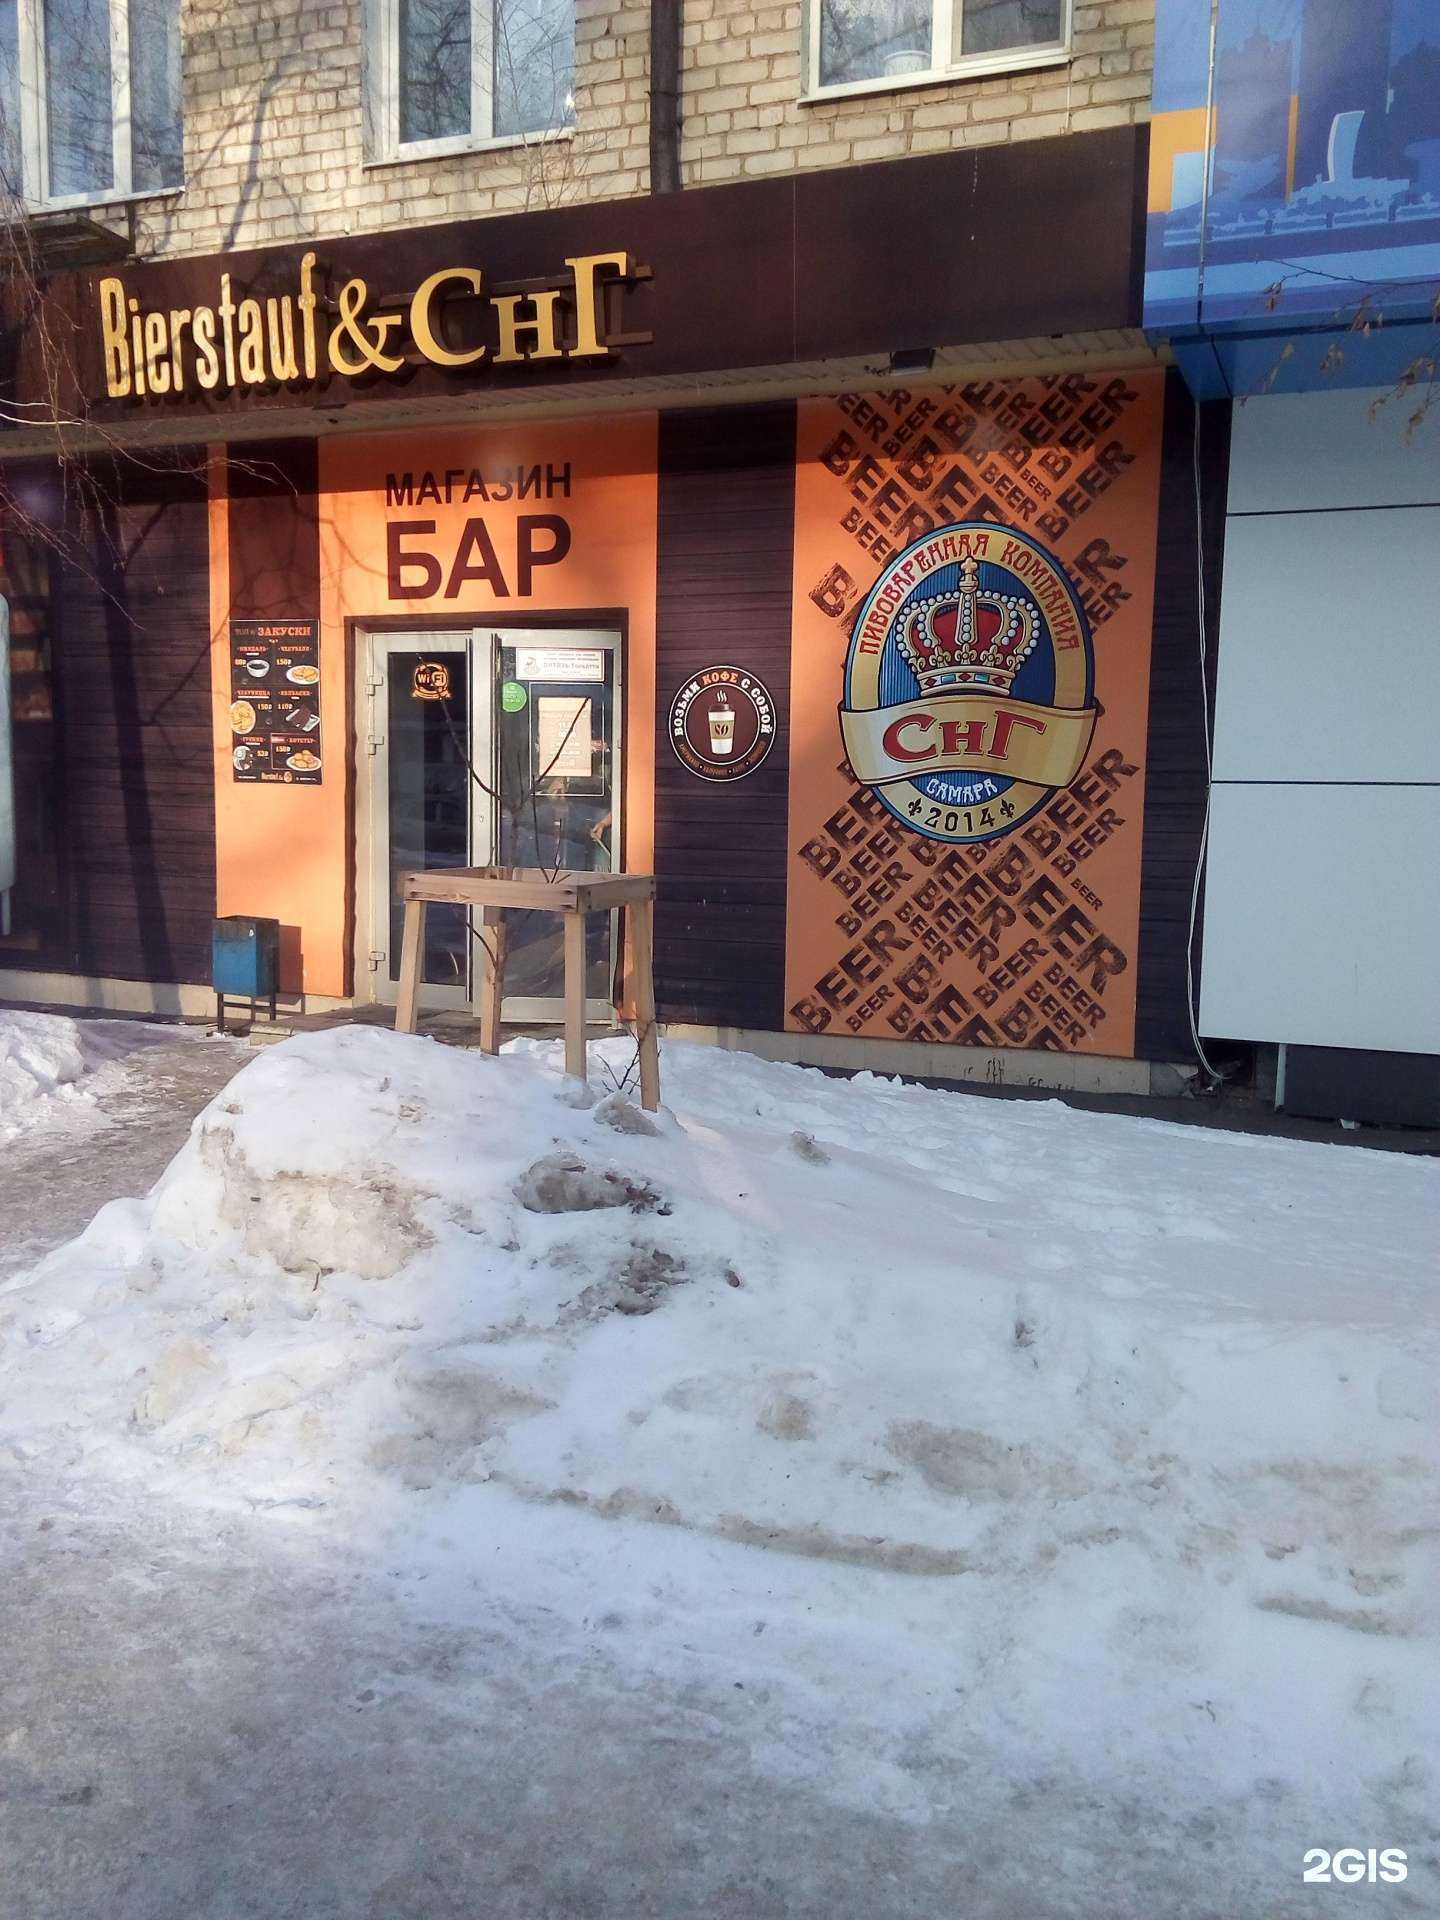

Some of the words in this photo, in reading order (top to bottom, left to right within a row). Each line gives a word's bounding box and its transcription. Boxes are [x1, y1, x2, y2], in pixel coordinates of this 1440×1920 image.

[328, 277, 405, 377] &
[881, 398, 939, 459] BEER
[998, 373, 1099, 474] BEER
[1037, 378, 1140, 483] BEER
[385, 462, 572, 508] МАГАЗИН
[979, 462, 1038, 522] BEER
[1020, 468, 1052, 501] BEER
[1035, 439, 1138, 544] BEER
[386, 513, 572, 601] БАР
[859, 533, 990, 656] ПИВОВАРЕННАЯ
[1000, 540, 1080, 652] КОМПАНИЯ
[673, 681, 701, 737] ВОЗЬМИ
[702, 670, 739, 686] КОФЕ
[741, 678, 751, 689] С
[750, 687, 773, 735] СОБОЙ
[923, 805, 997, 834] 2014
[925, 777, 998, 806] САМАРА
[1021, 748, 1141, 861] BEER
[1050, 808, 1127, 878] BEER
[835, 861, 914, 939] BEER
[911, 878, 1000, 975] BEER
[983, 843, 1128, 997] BEER
[1070, 877, 1104, 912] BEER
[895, 900, 954, 965] BEER
[789, 919, 914, 1033] BEER
[846, 984, 896, 1033] BEER
[972, 938, 1050, 1010] BEER
[1043, 961, 1107, 1029] BEER
[1024, 980, 1087, 1047] BEER
